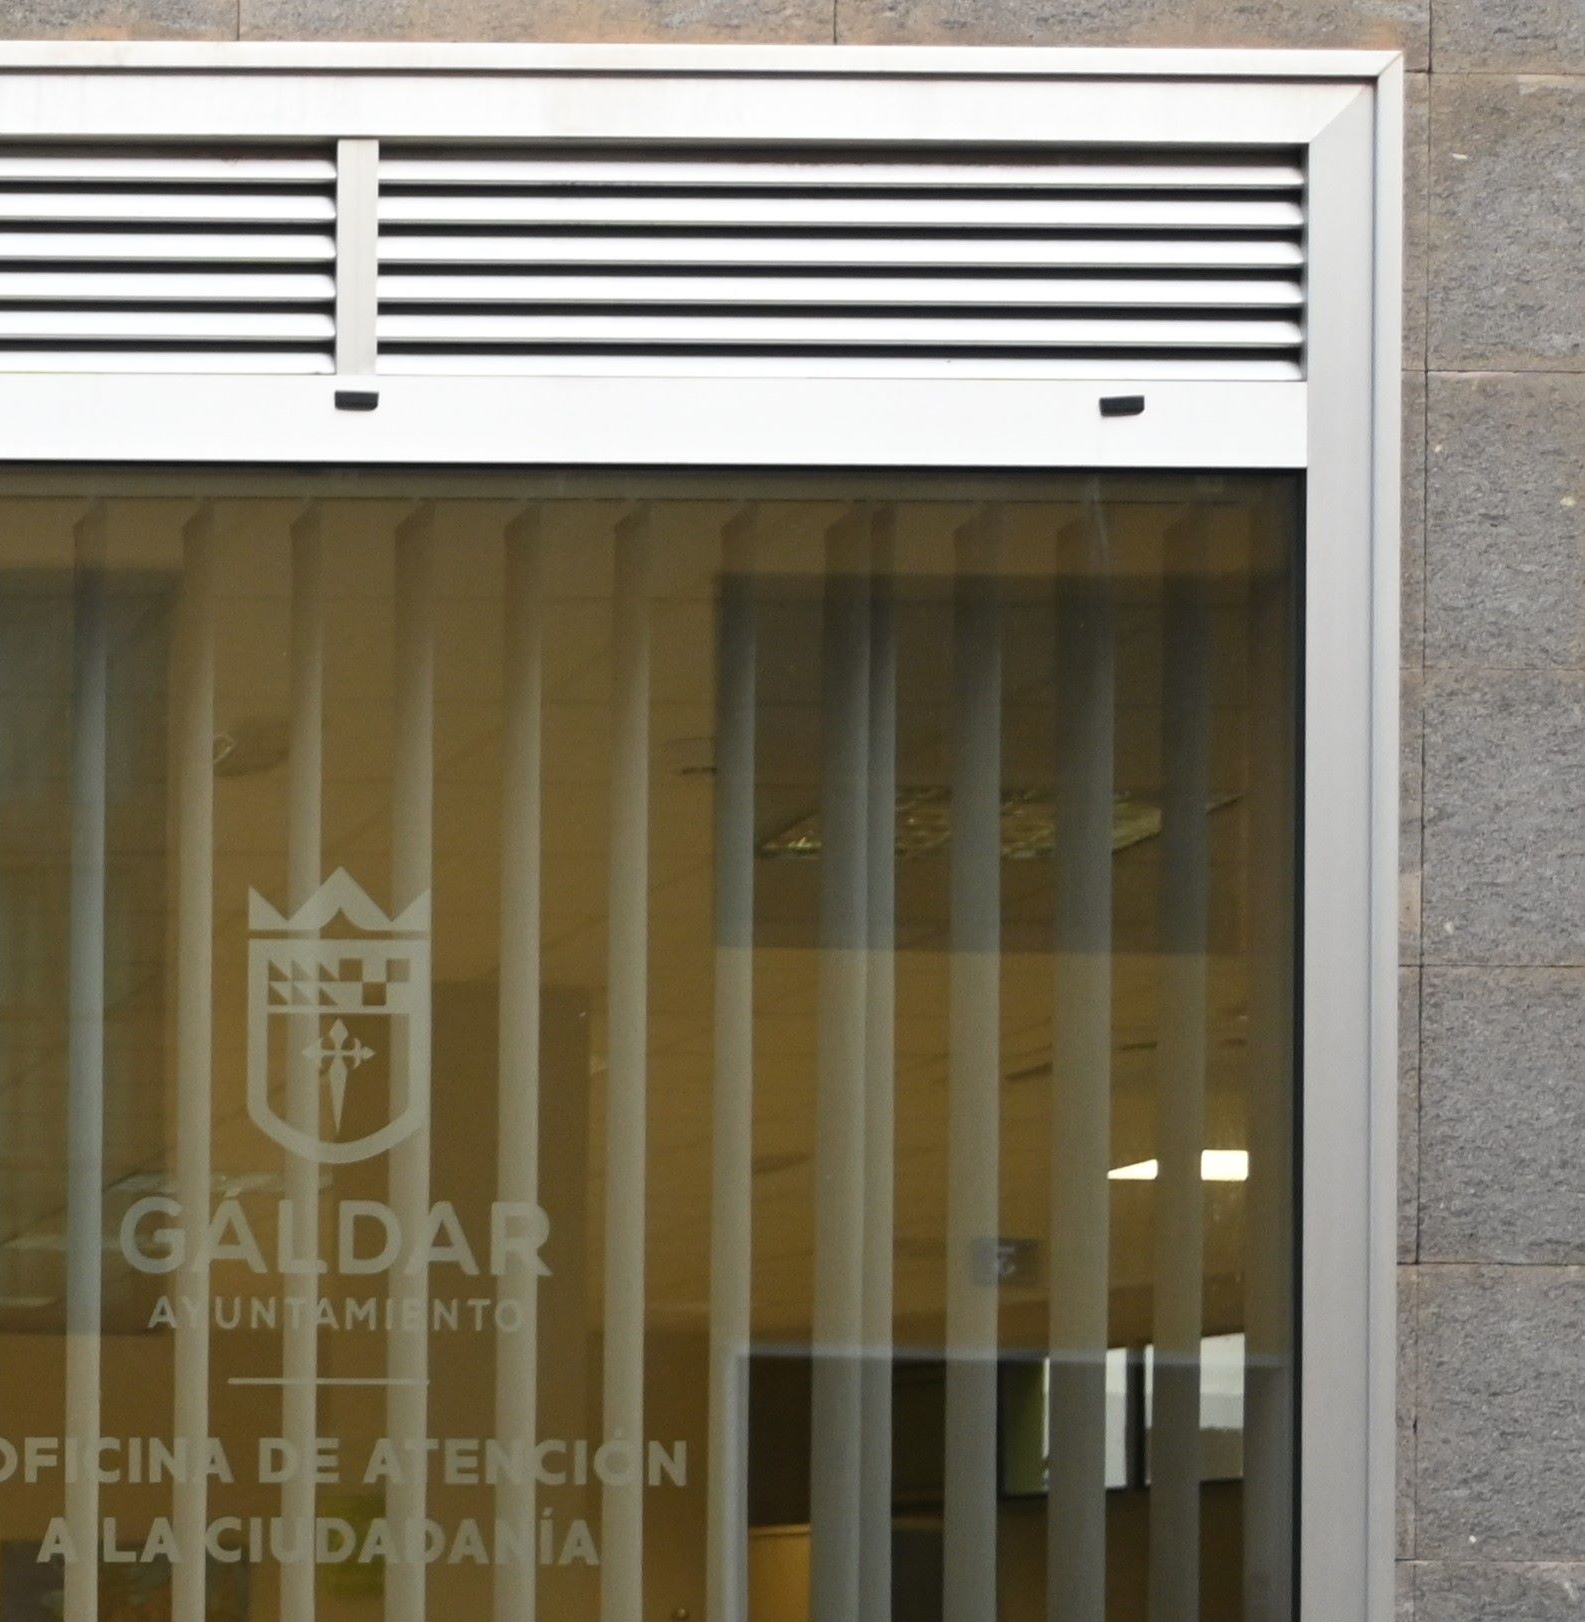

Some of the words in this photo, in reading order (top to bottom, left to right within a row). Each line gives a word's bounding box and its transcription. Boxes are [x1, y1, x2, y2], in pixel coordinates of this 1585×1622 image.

[118, 1190, 554, 1277] GÁLDAR
[147, 1295, 526, 1332] AYUNTAMIENTO
[258, 1437, 340, 1486] DE
[363, 1428, 688, 1487] ATENCIÓN
[36, 1516, 69, 1563] A
[102, 1516, 179, 1564] LA
[203, 1508, 601, 1566] CIUDADANÍA
